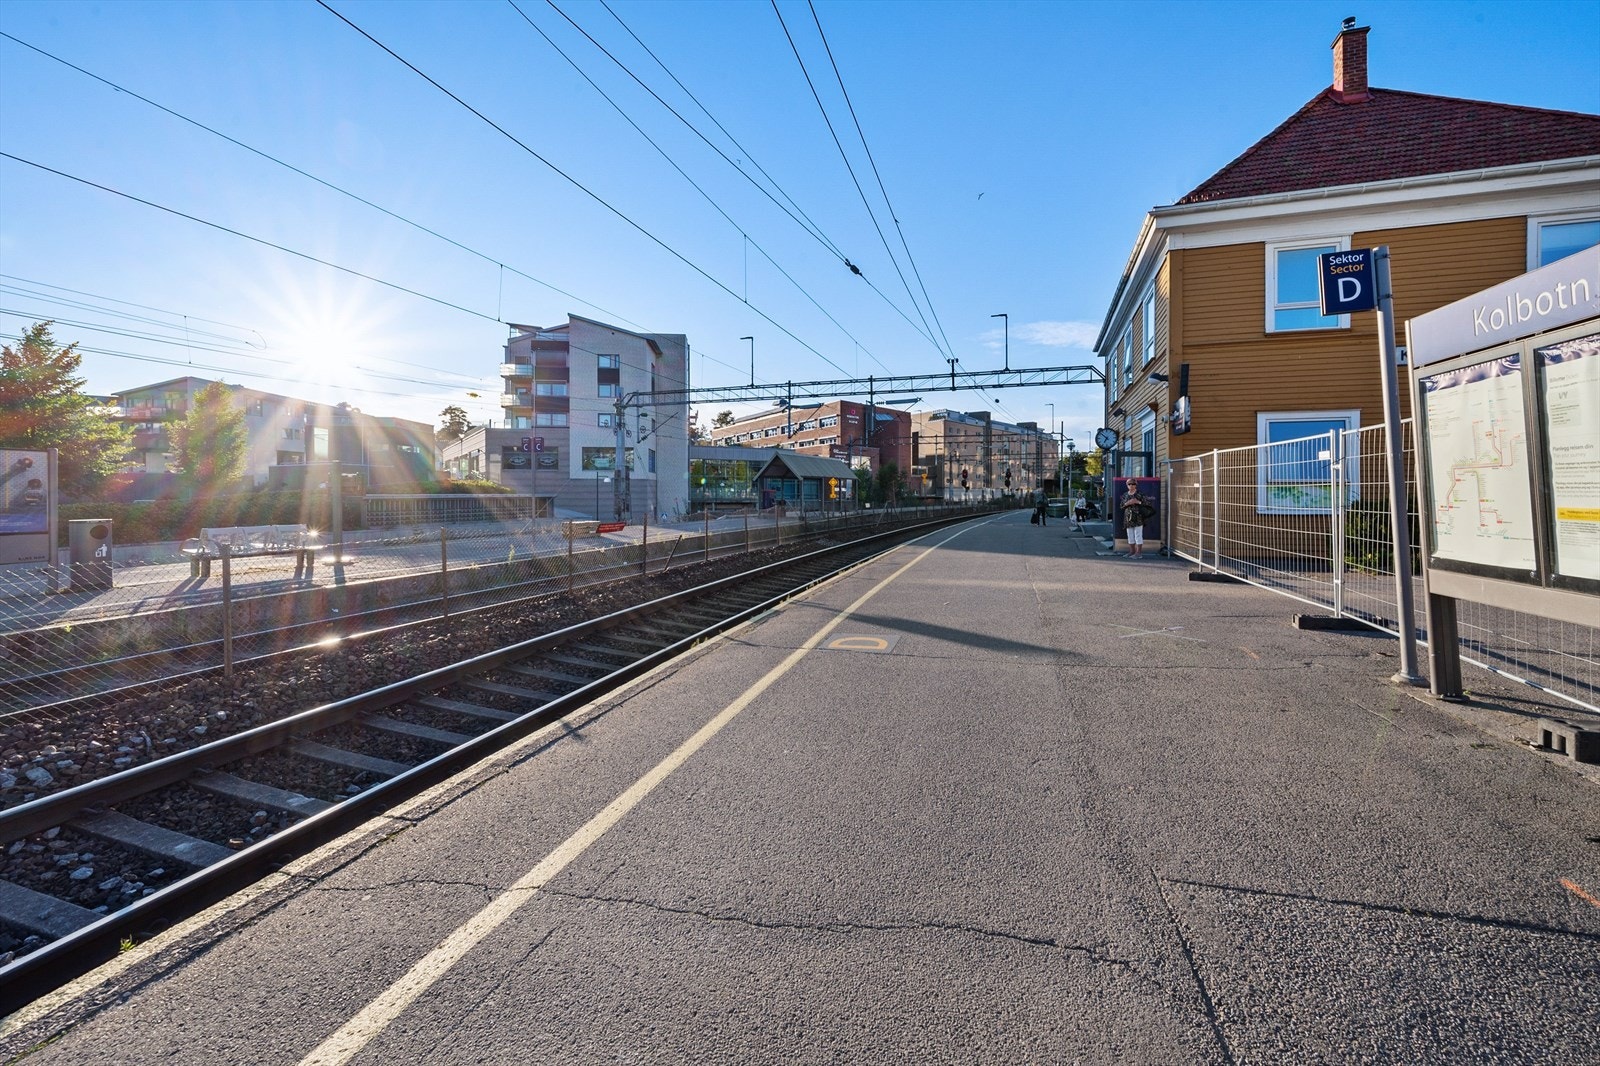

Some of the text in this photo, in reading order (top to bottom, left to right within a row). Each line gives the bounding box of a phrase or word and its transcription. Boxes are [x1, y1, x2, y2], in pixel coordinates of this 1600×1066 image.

[1329, 254, 1364, 265] Sektor
[1330, 264, 1365, 275] Sector
[1337, 277, 1362, 302] D
[1473, 278, 1590, 336] Kolbotn
[523, 443, 529, 451] C
[535, 443, 541, 451] C
[828, 636, 888, 650] D
